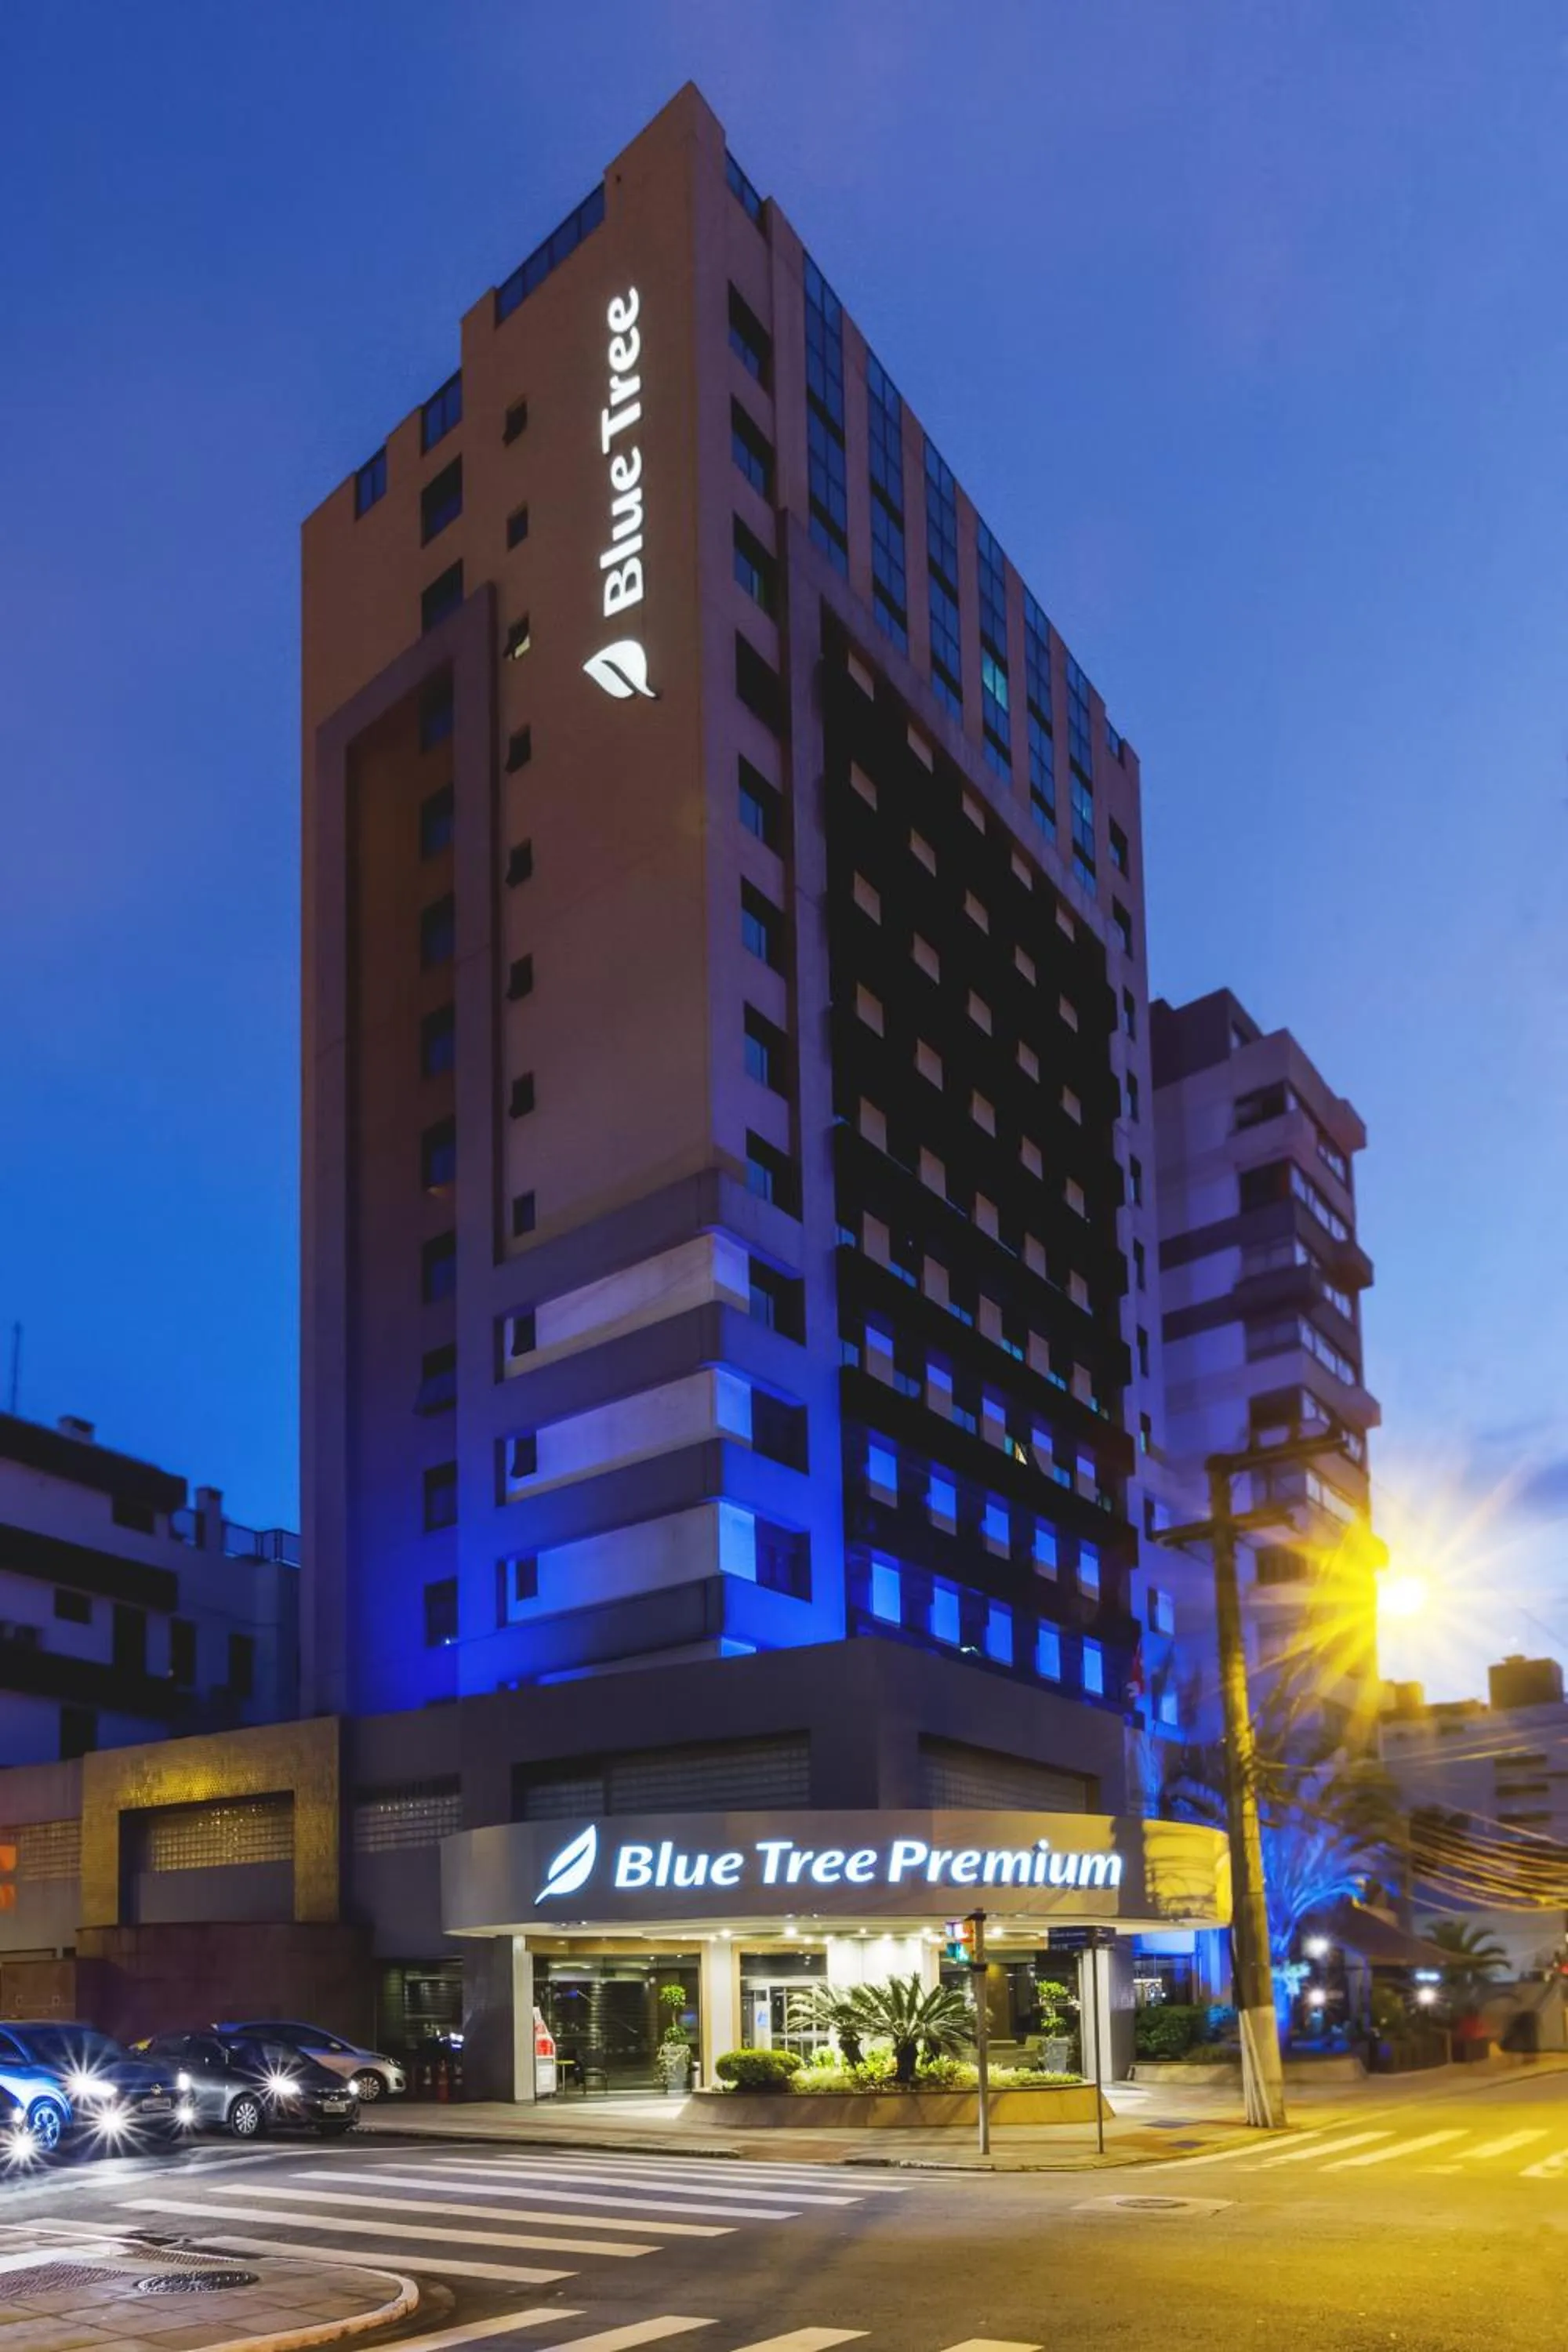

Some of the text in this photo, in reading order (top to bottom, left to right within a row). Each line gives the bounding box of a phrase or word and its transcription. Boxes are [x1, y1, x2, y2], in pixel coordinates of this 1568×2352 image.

[600, 287, 644, 618] Blue Tree
[614, 1838, 1123, 1888] Blue Tree Premium
